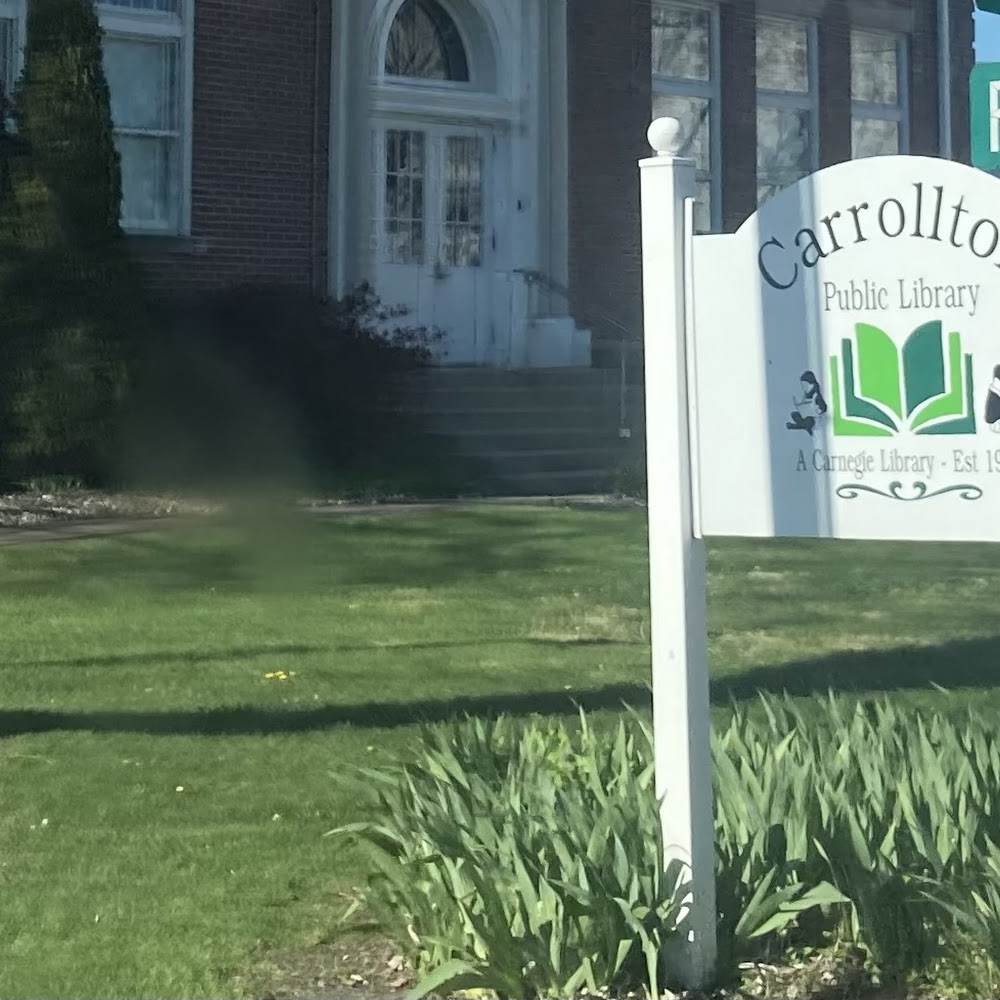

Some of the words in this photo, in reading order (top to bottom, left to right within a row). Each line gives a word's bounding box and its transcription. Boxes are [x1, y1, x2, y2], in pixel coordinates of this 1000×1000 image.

[757, 181, 1000, 290] Carrollto
[823, 279, 889, 312] Public
[898, 277, 981, 317] Library
[796, 449, 808, 472] A
[812, 448, 875, 480] Carnegie
[880, 448, 935, 480] Library
[953, 449, 980, 473] Est
